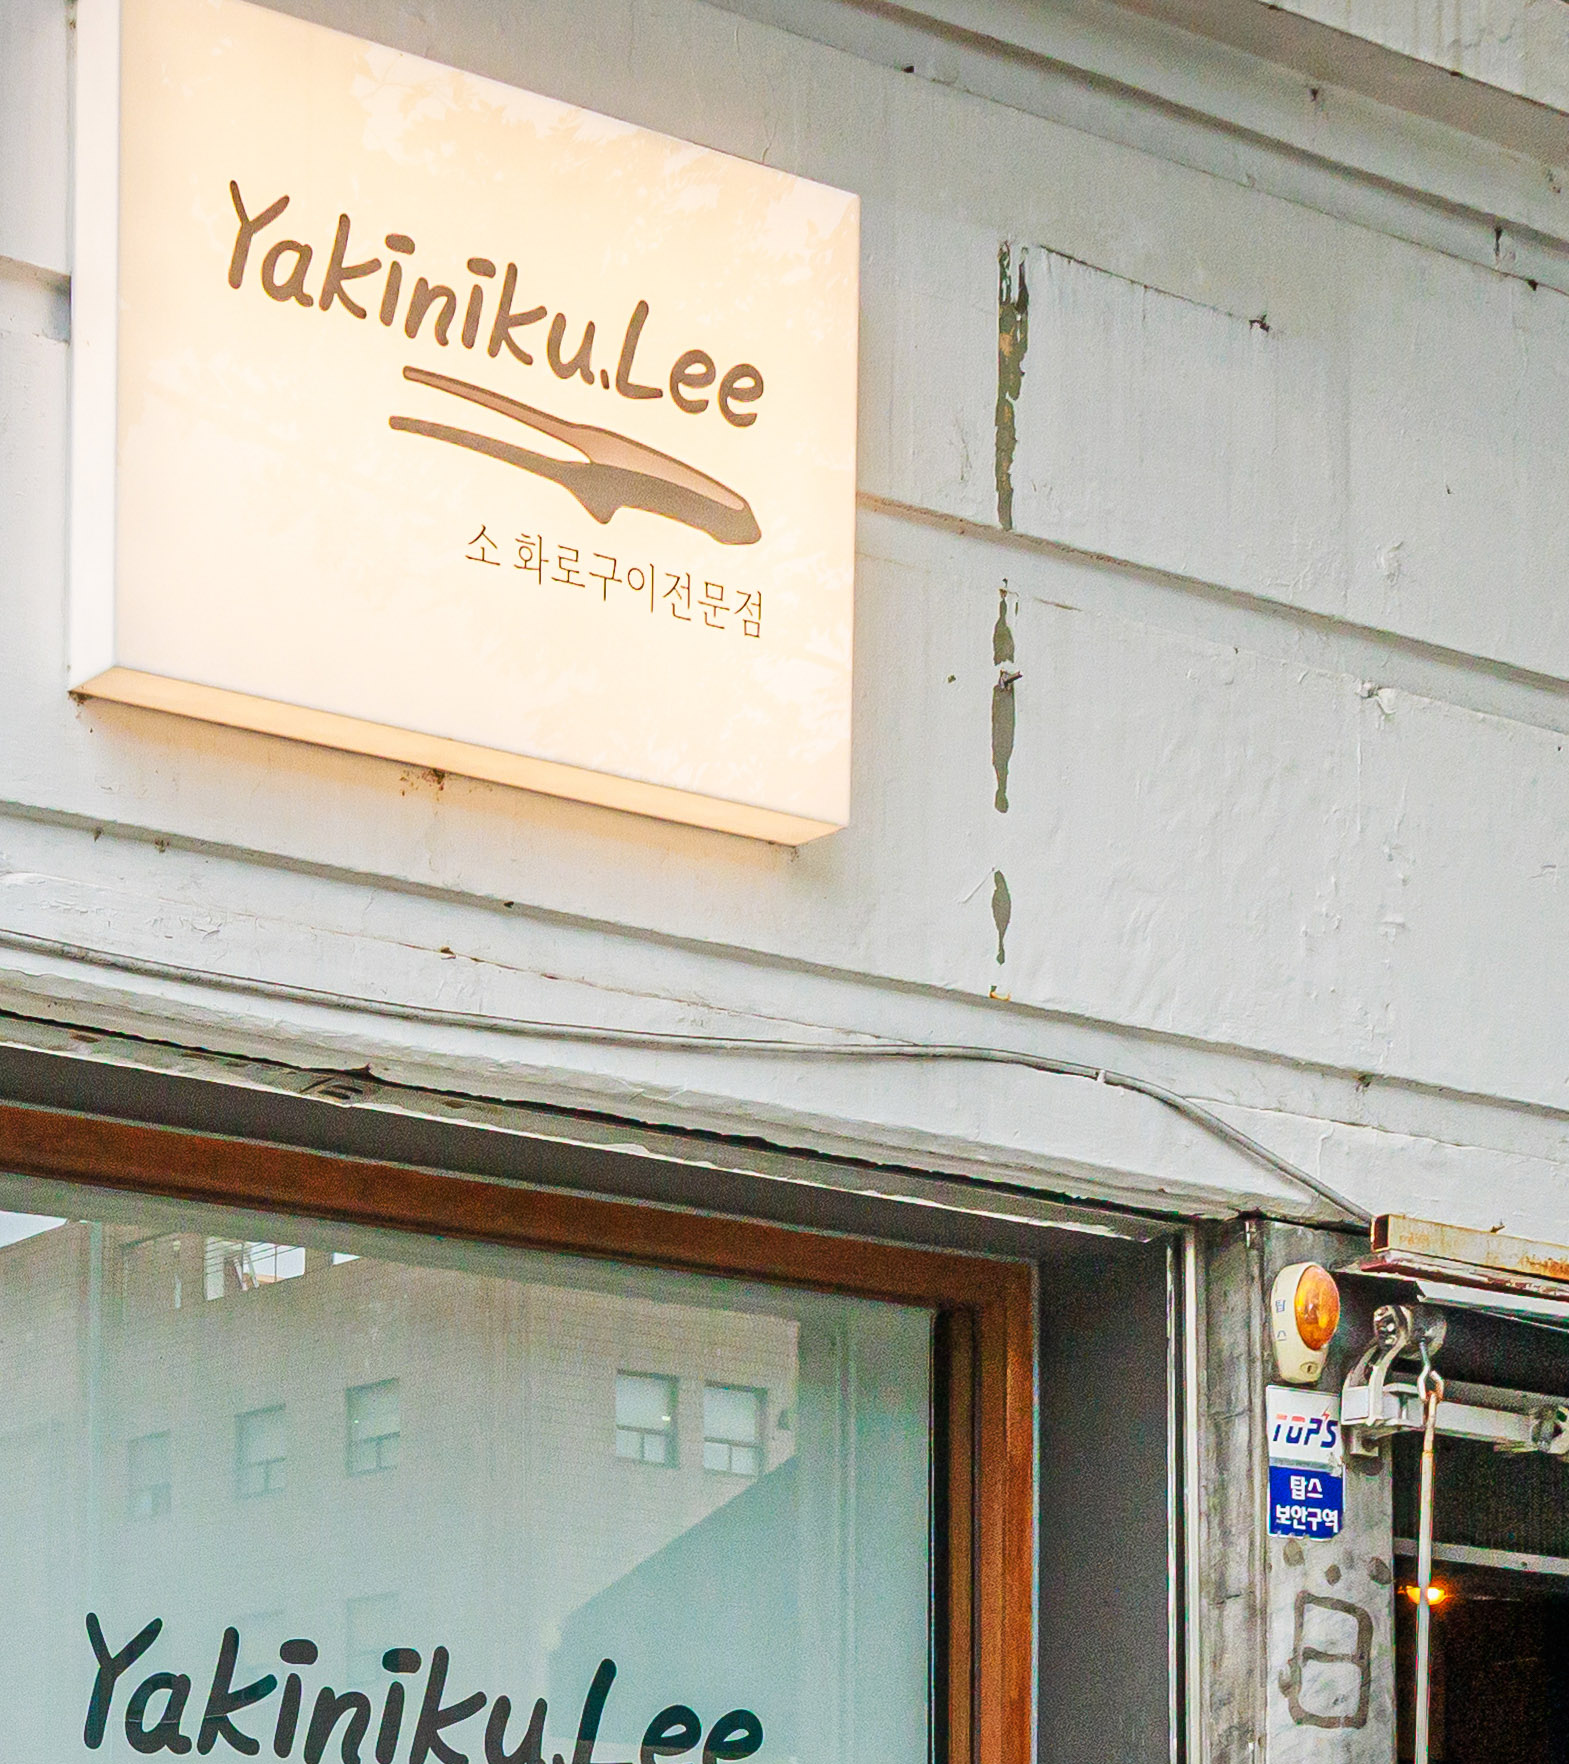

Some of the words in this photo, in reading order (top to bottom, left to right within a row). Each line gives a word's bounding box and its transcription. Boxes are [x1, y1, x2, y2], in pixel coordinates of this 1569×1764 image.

[227, 180, 764, 427] Yakiniku.Lee
[465, 525, 500, 567] 소
[514, 534, 762, 638] 화로구이전문점
[1273, 1412, 1338, 1449] TOPS
[1290, 1475, 1323, 1500] 탑스
[1275, 1504, 1339, 1533] 보안구역
